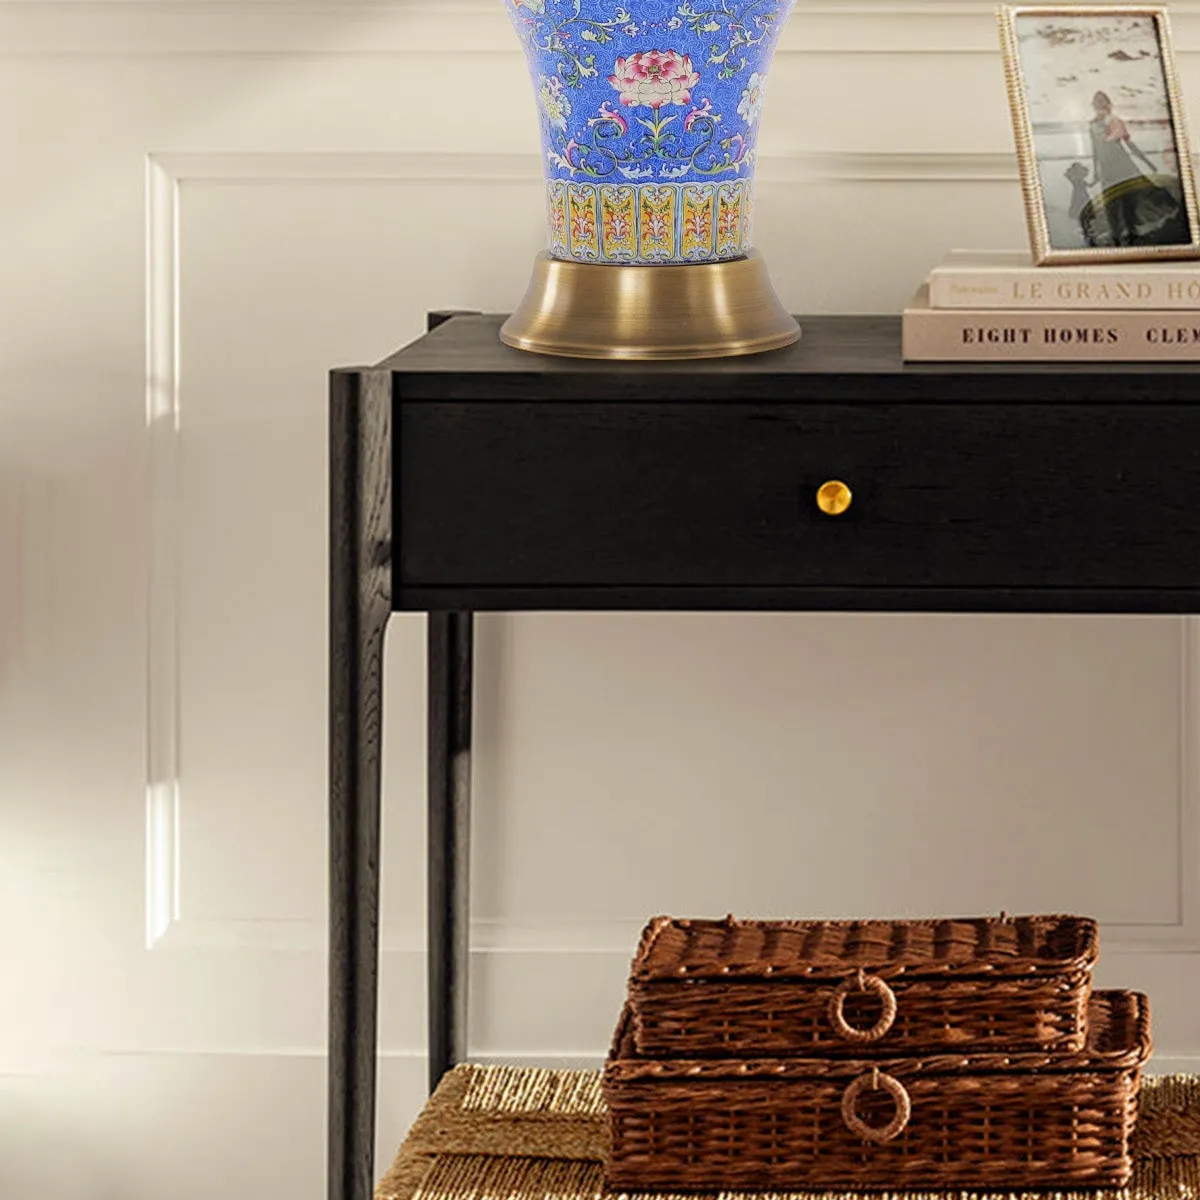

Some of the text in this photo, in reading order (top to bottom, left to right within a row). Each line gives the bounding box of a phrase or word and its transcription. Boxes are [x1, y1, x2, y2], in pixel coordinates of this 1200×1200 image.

[1012, 281, 1043, 299] LE
[1056, 281, 1153, 299] GRAND
[962, 327, 1032, 344] EIGHT
[1043, 327, 1119, 344] HOMES
